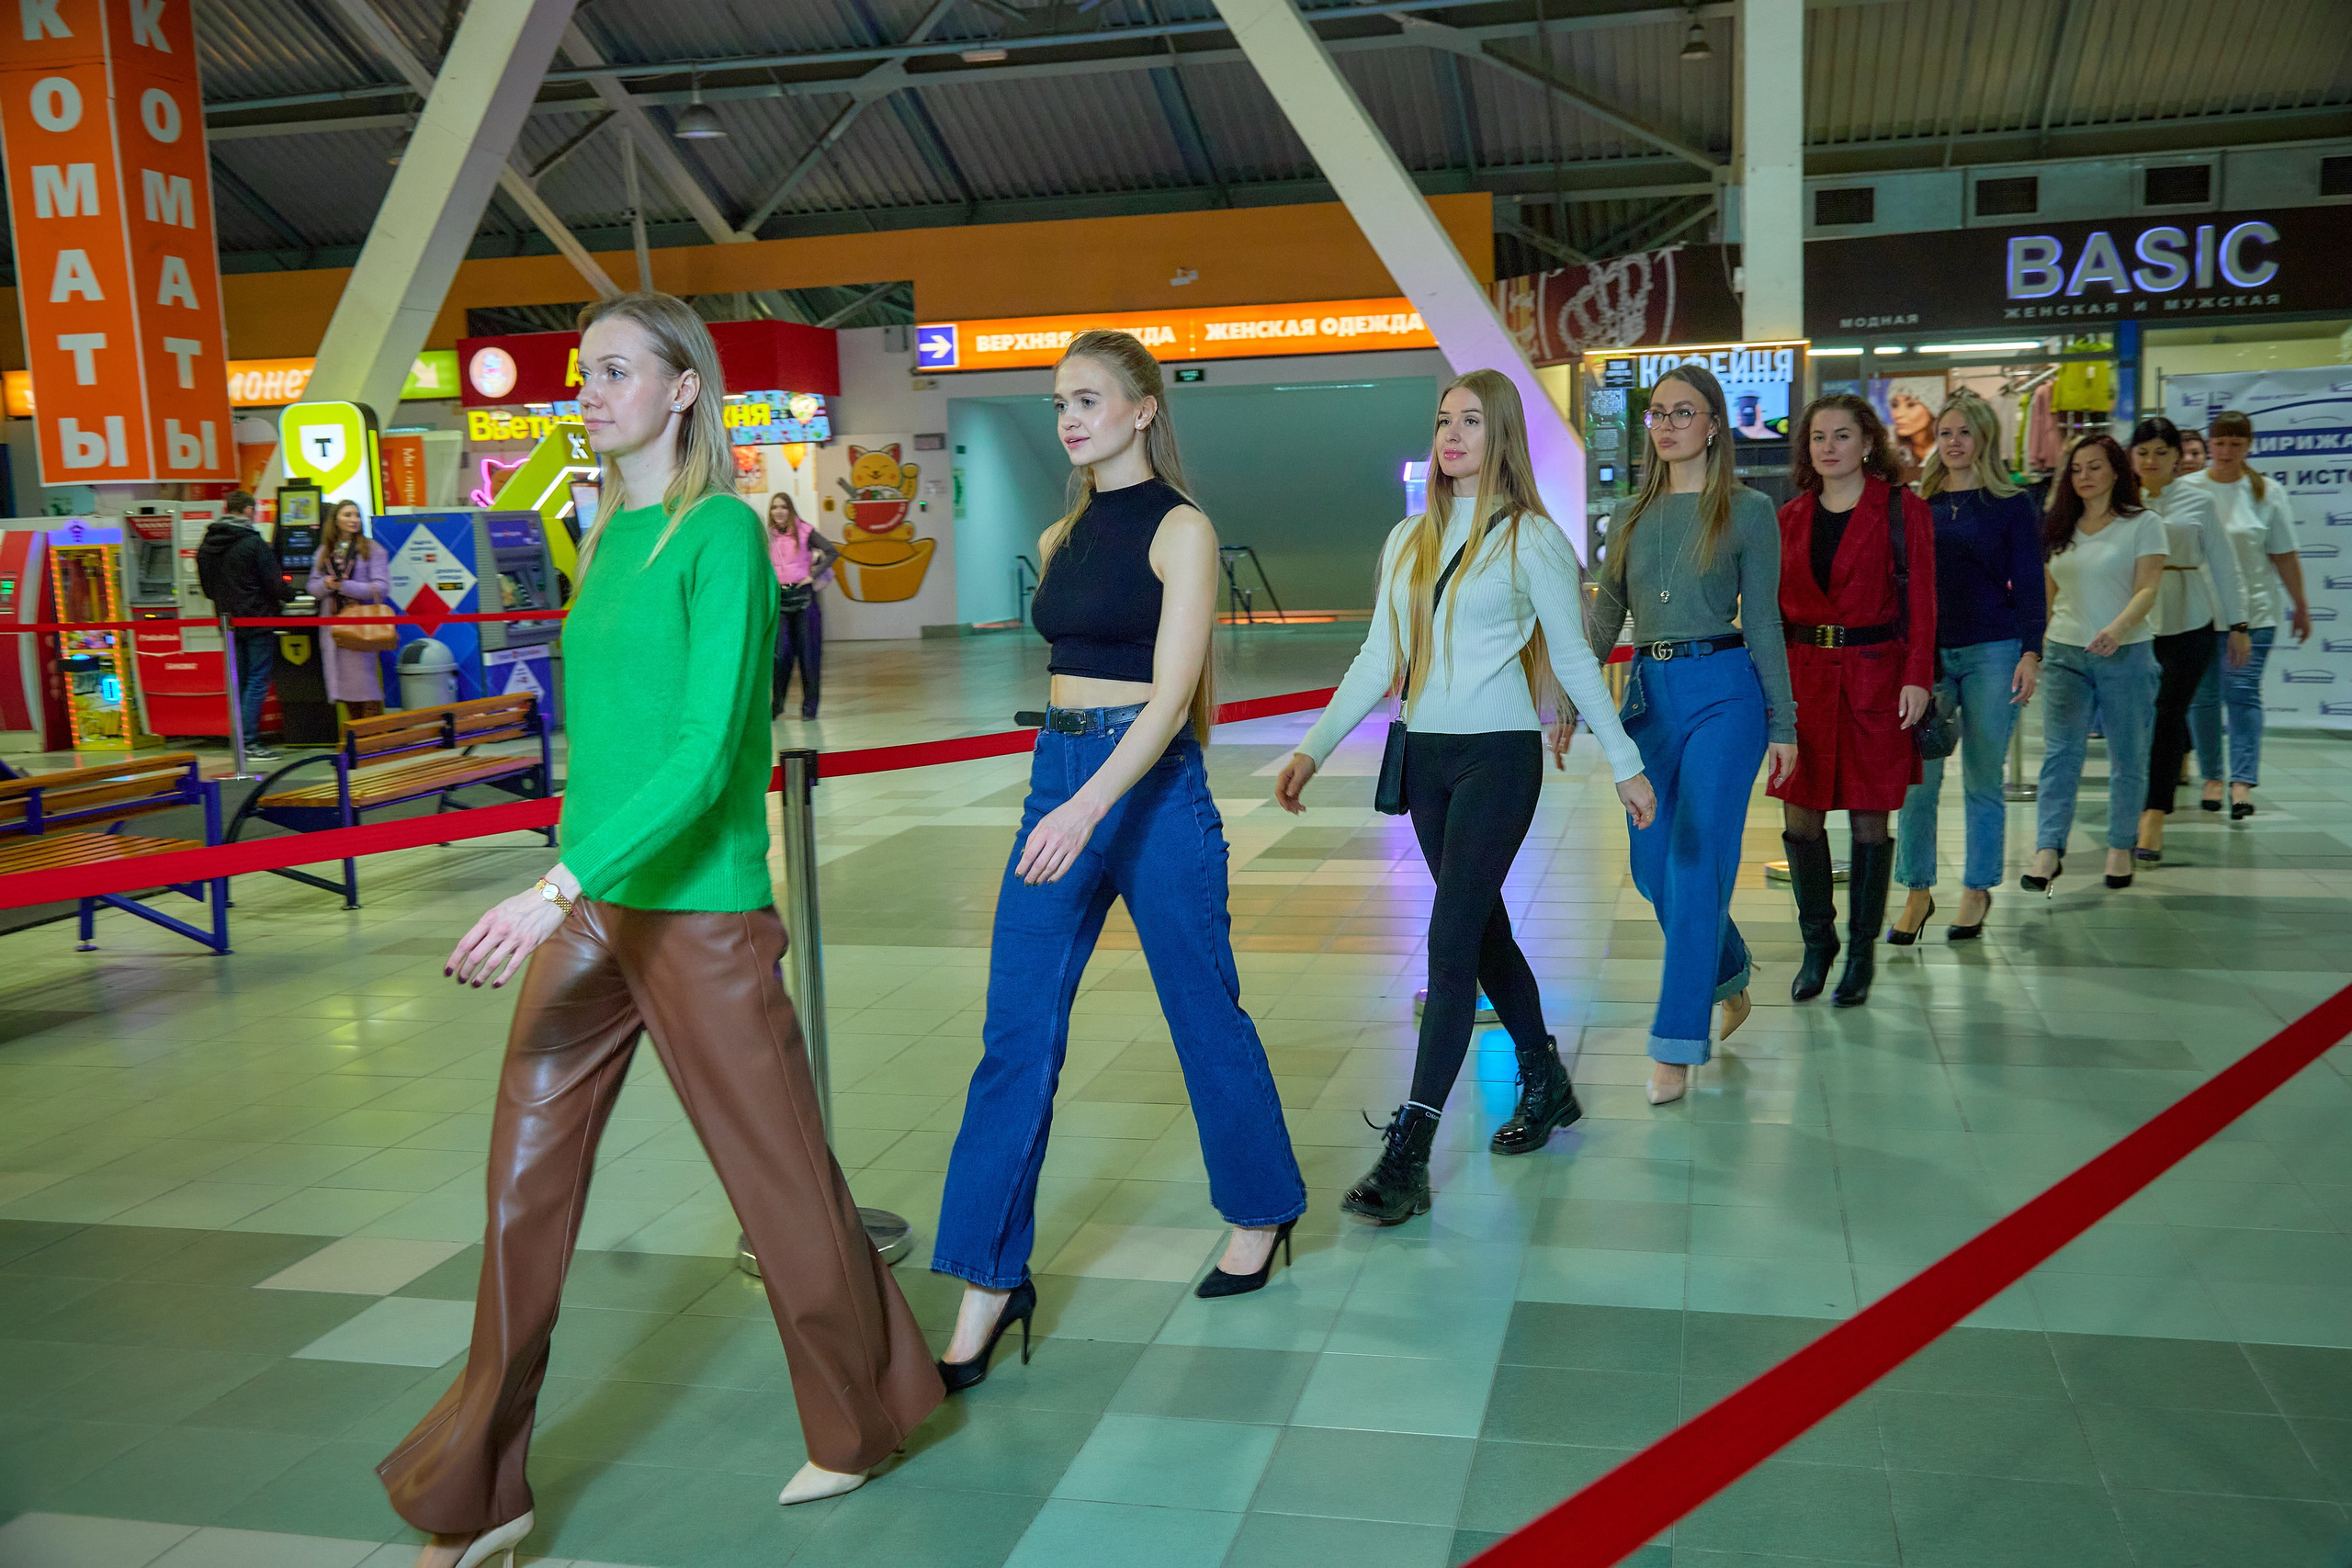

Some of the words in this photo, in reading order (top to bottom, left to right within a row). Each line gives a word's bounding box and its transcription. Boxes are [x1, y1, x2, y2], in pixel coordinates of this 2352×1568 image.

[2007, 220, 2280, 299] BASIC
[2003, 300, 2120, 320] ЖЕНСКАЯ
[2132, 300, 2147, 312] И
[2164, 293, 2282, 311] МУЖСКАЯ
[1204, 319, 1317, 341] ЖЕНСКАЯ
[1319, 312, 1426, 337] ОДЕЖДА
[1839, 313, 1919, 329] МОДНАЯ
[976, 331, 1073, 352] ВЕРХНЯЯ
[2297, 468, 2352, 485] ИСТ
